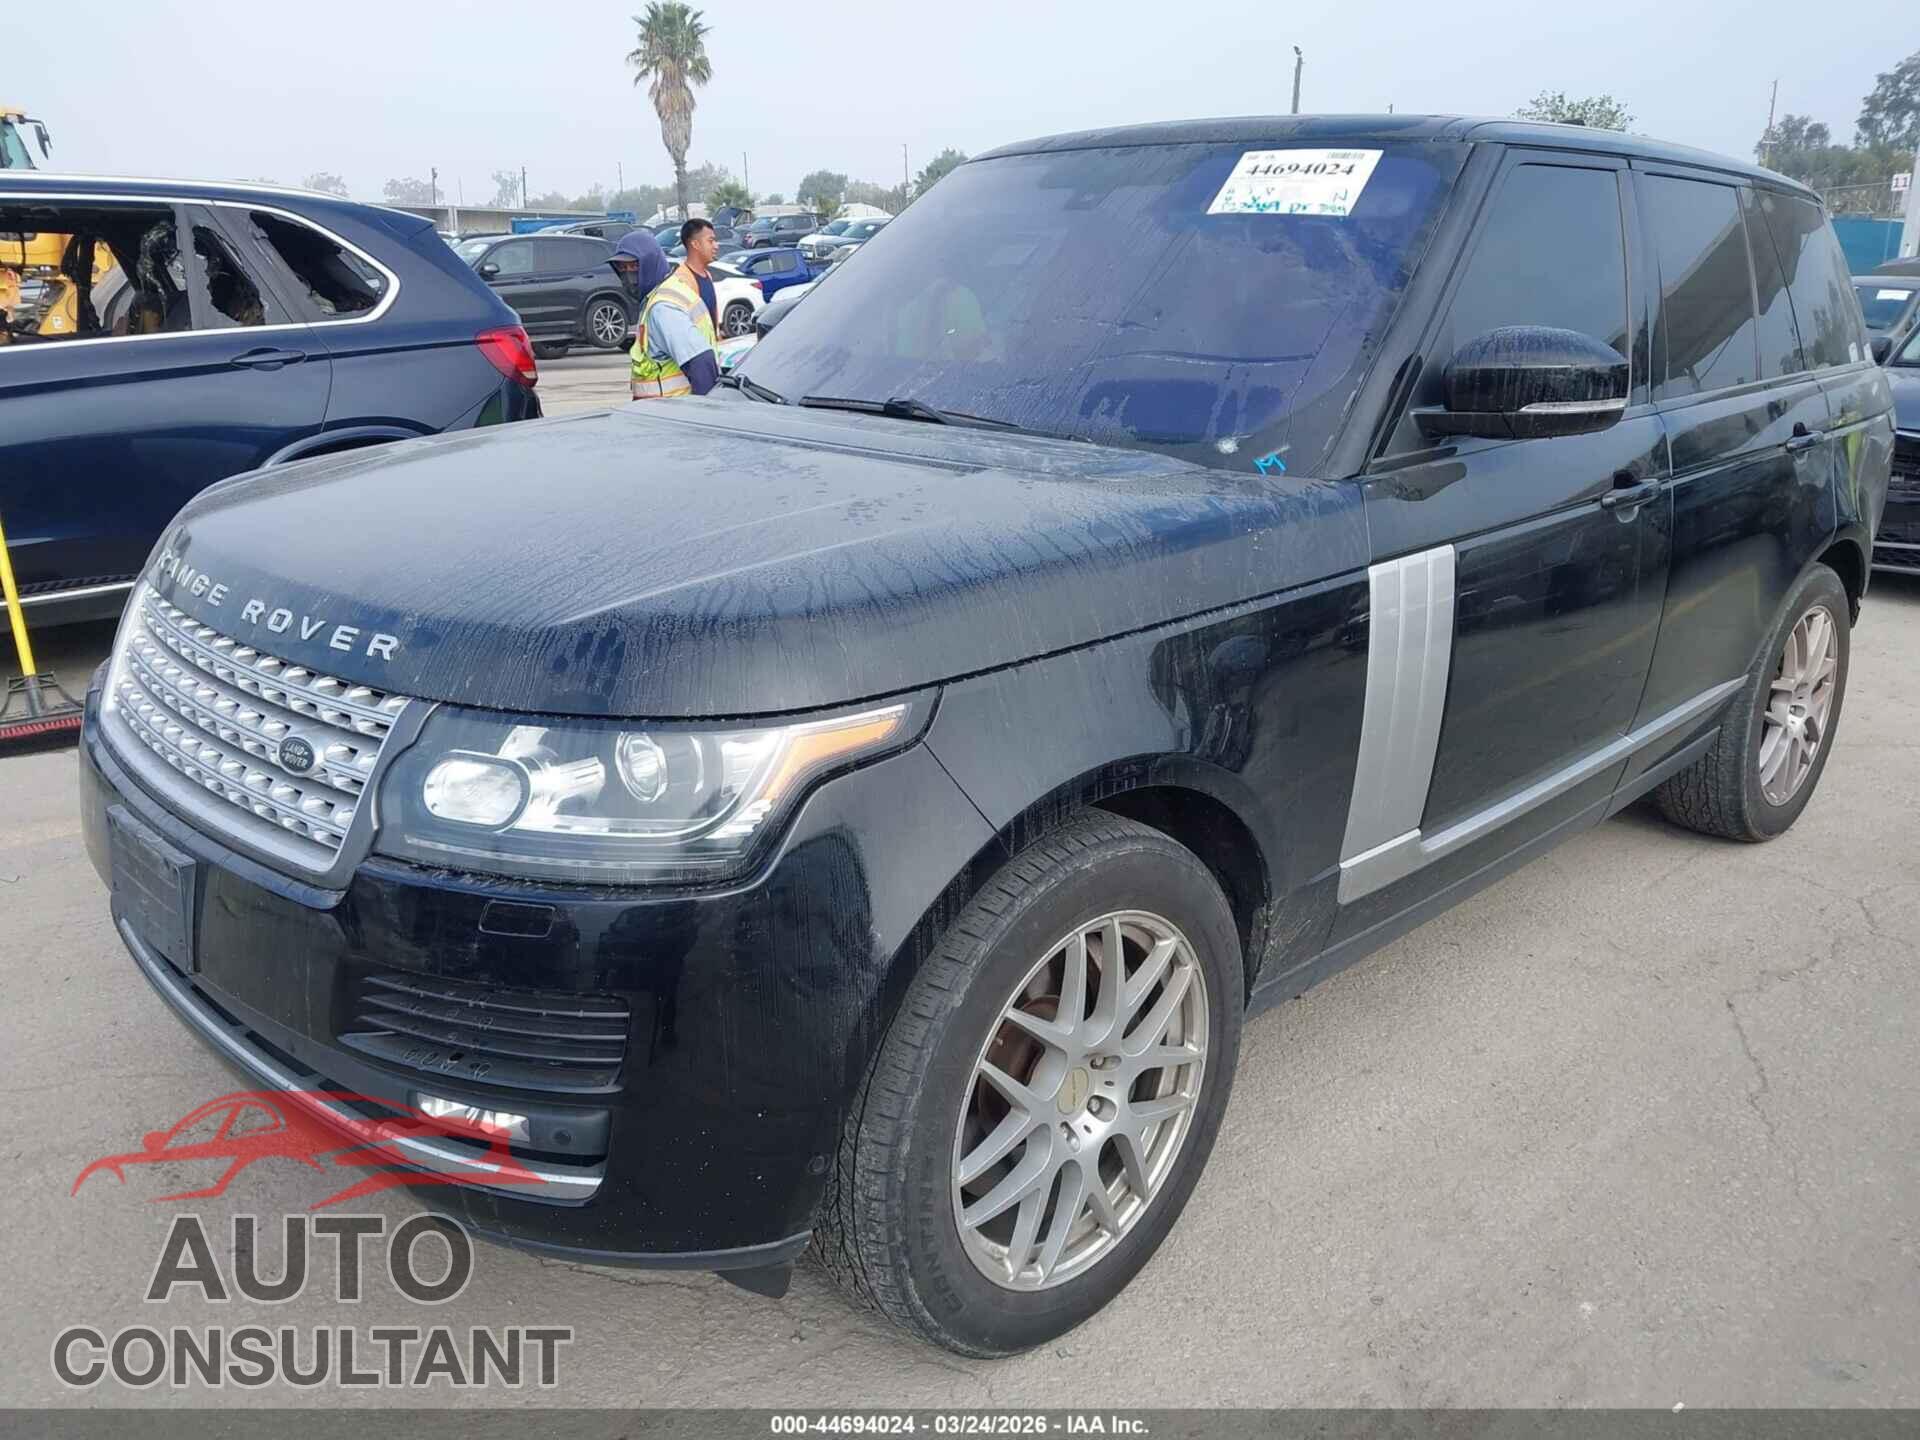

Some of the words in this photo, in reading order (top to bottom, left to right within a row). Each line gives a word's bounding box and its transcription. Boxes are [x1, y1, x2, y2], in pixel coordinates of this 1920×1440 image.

[1247, 162, 1356, 176] 44694024
[157, 549, 231, 607] RANGE
[240, 599, 401, 661] ROVER
